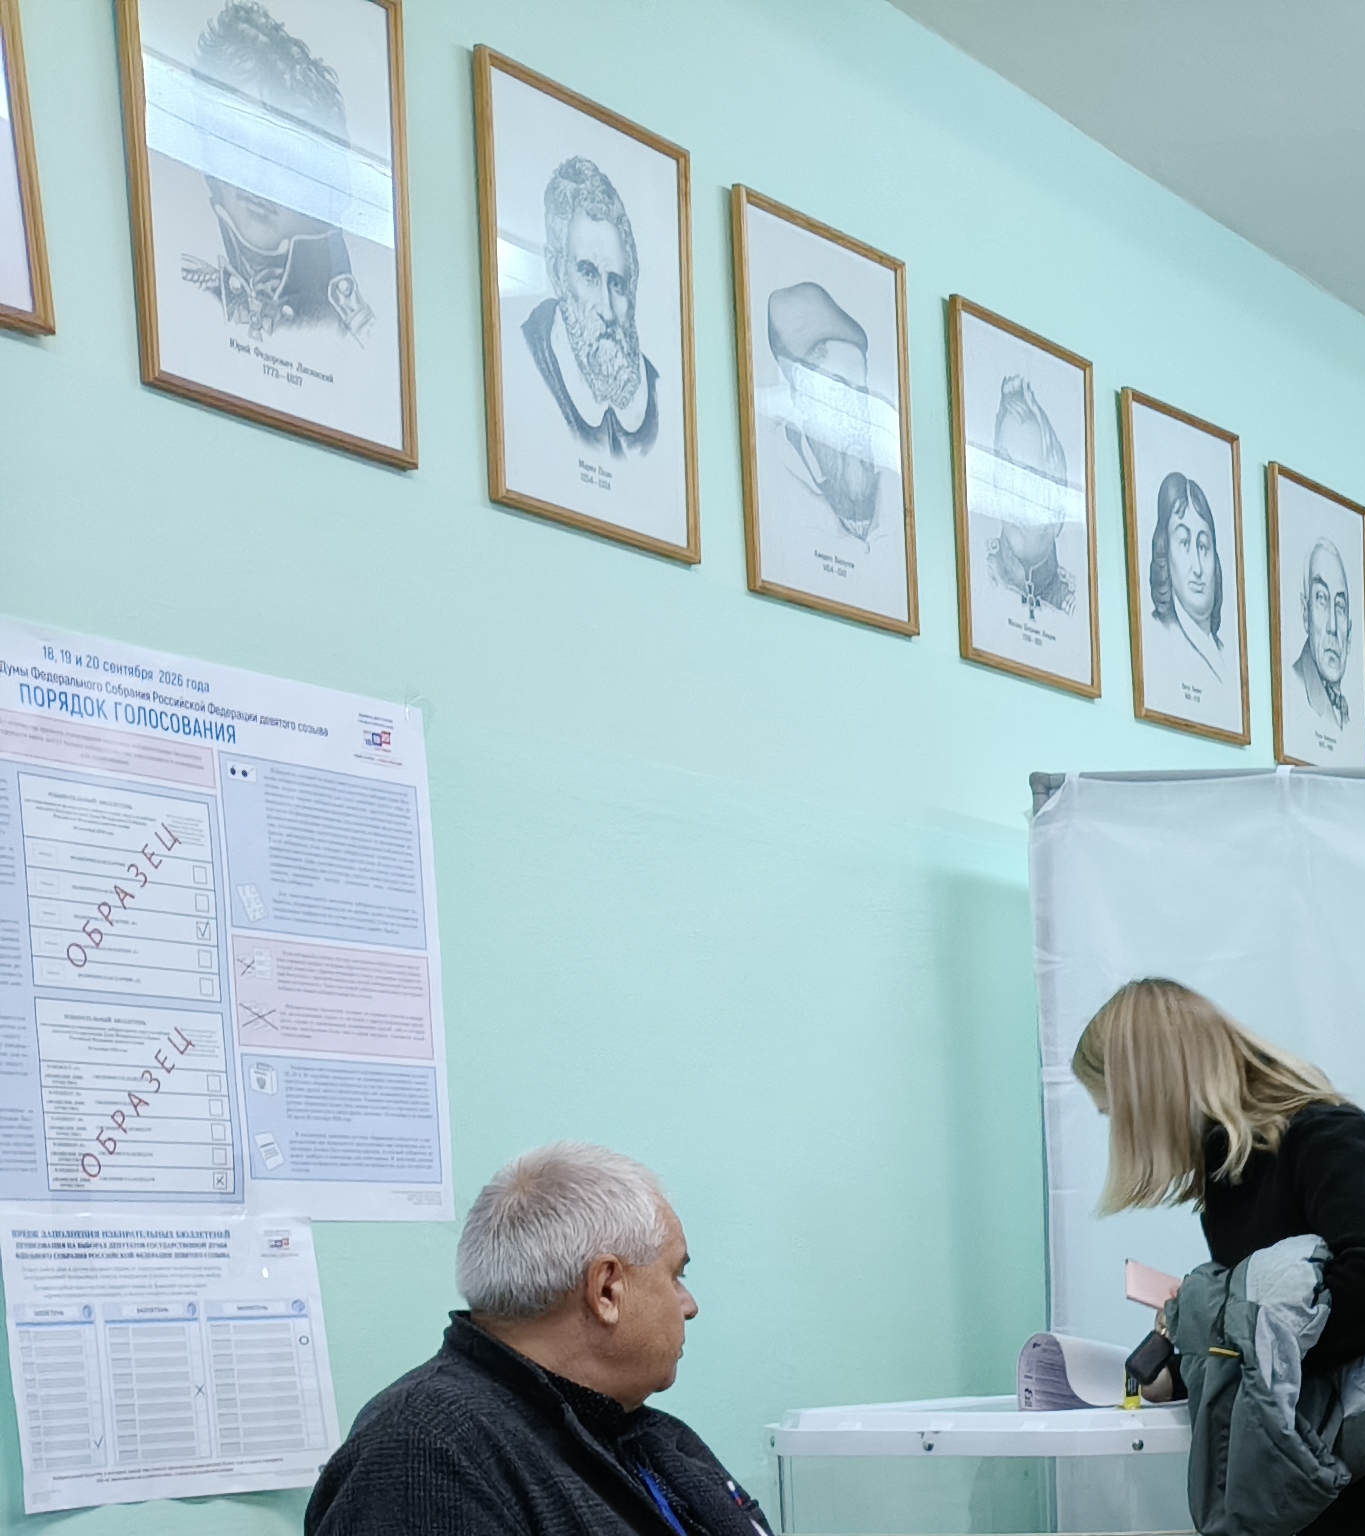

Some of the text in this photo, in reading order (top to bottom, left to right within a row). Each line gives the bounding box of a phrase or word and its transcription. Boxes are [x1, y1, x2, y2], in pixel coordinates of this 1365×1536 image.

[31, 666, 103, 692] Федерального
[105, 681, 151, 702] Собрания
[152, 691, 206, 714] Российской
[75, 654, 83, 666] и
[86, 654, 100, 670] 20
[103, 660, 154, 682] сентября
[159, 669, 184, 687] 2026
[186, 678, 211, 694] года
[19, 683, 109, 720] ПОРЯДОК
[114, 701, 237, 744] ГОЛОСОВАНИЯ
[66, 822, 183, 968] ОБРАЗЕЦ
[81, 1026, 196, 1178] ОБРАЗЕЦ
